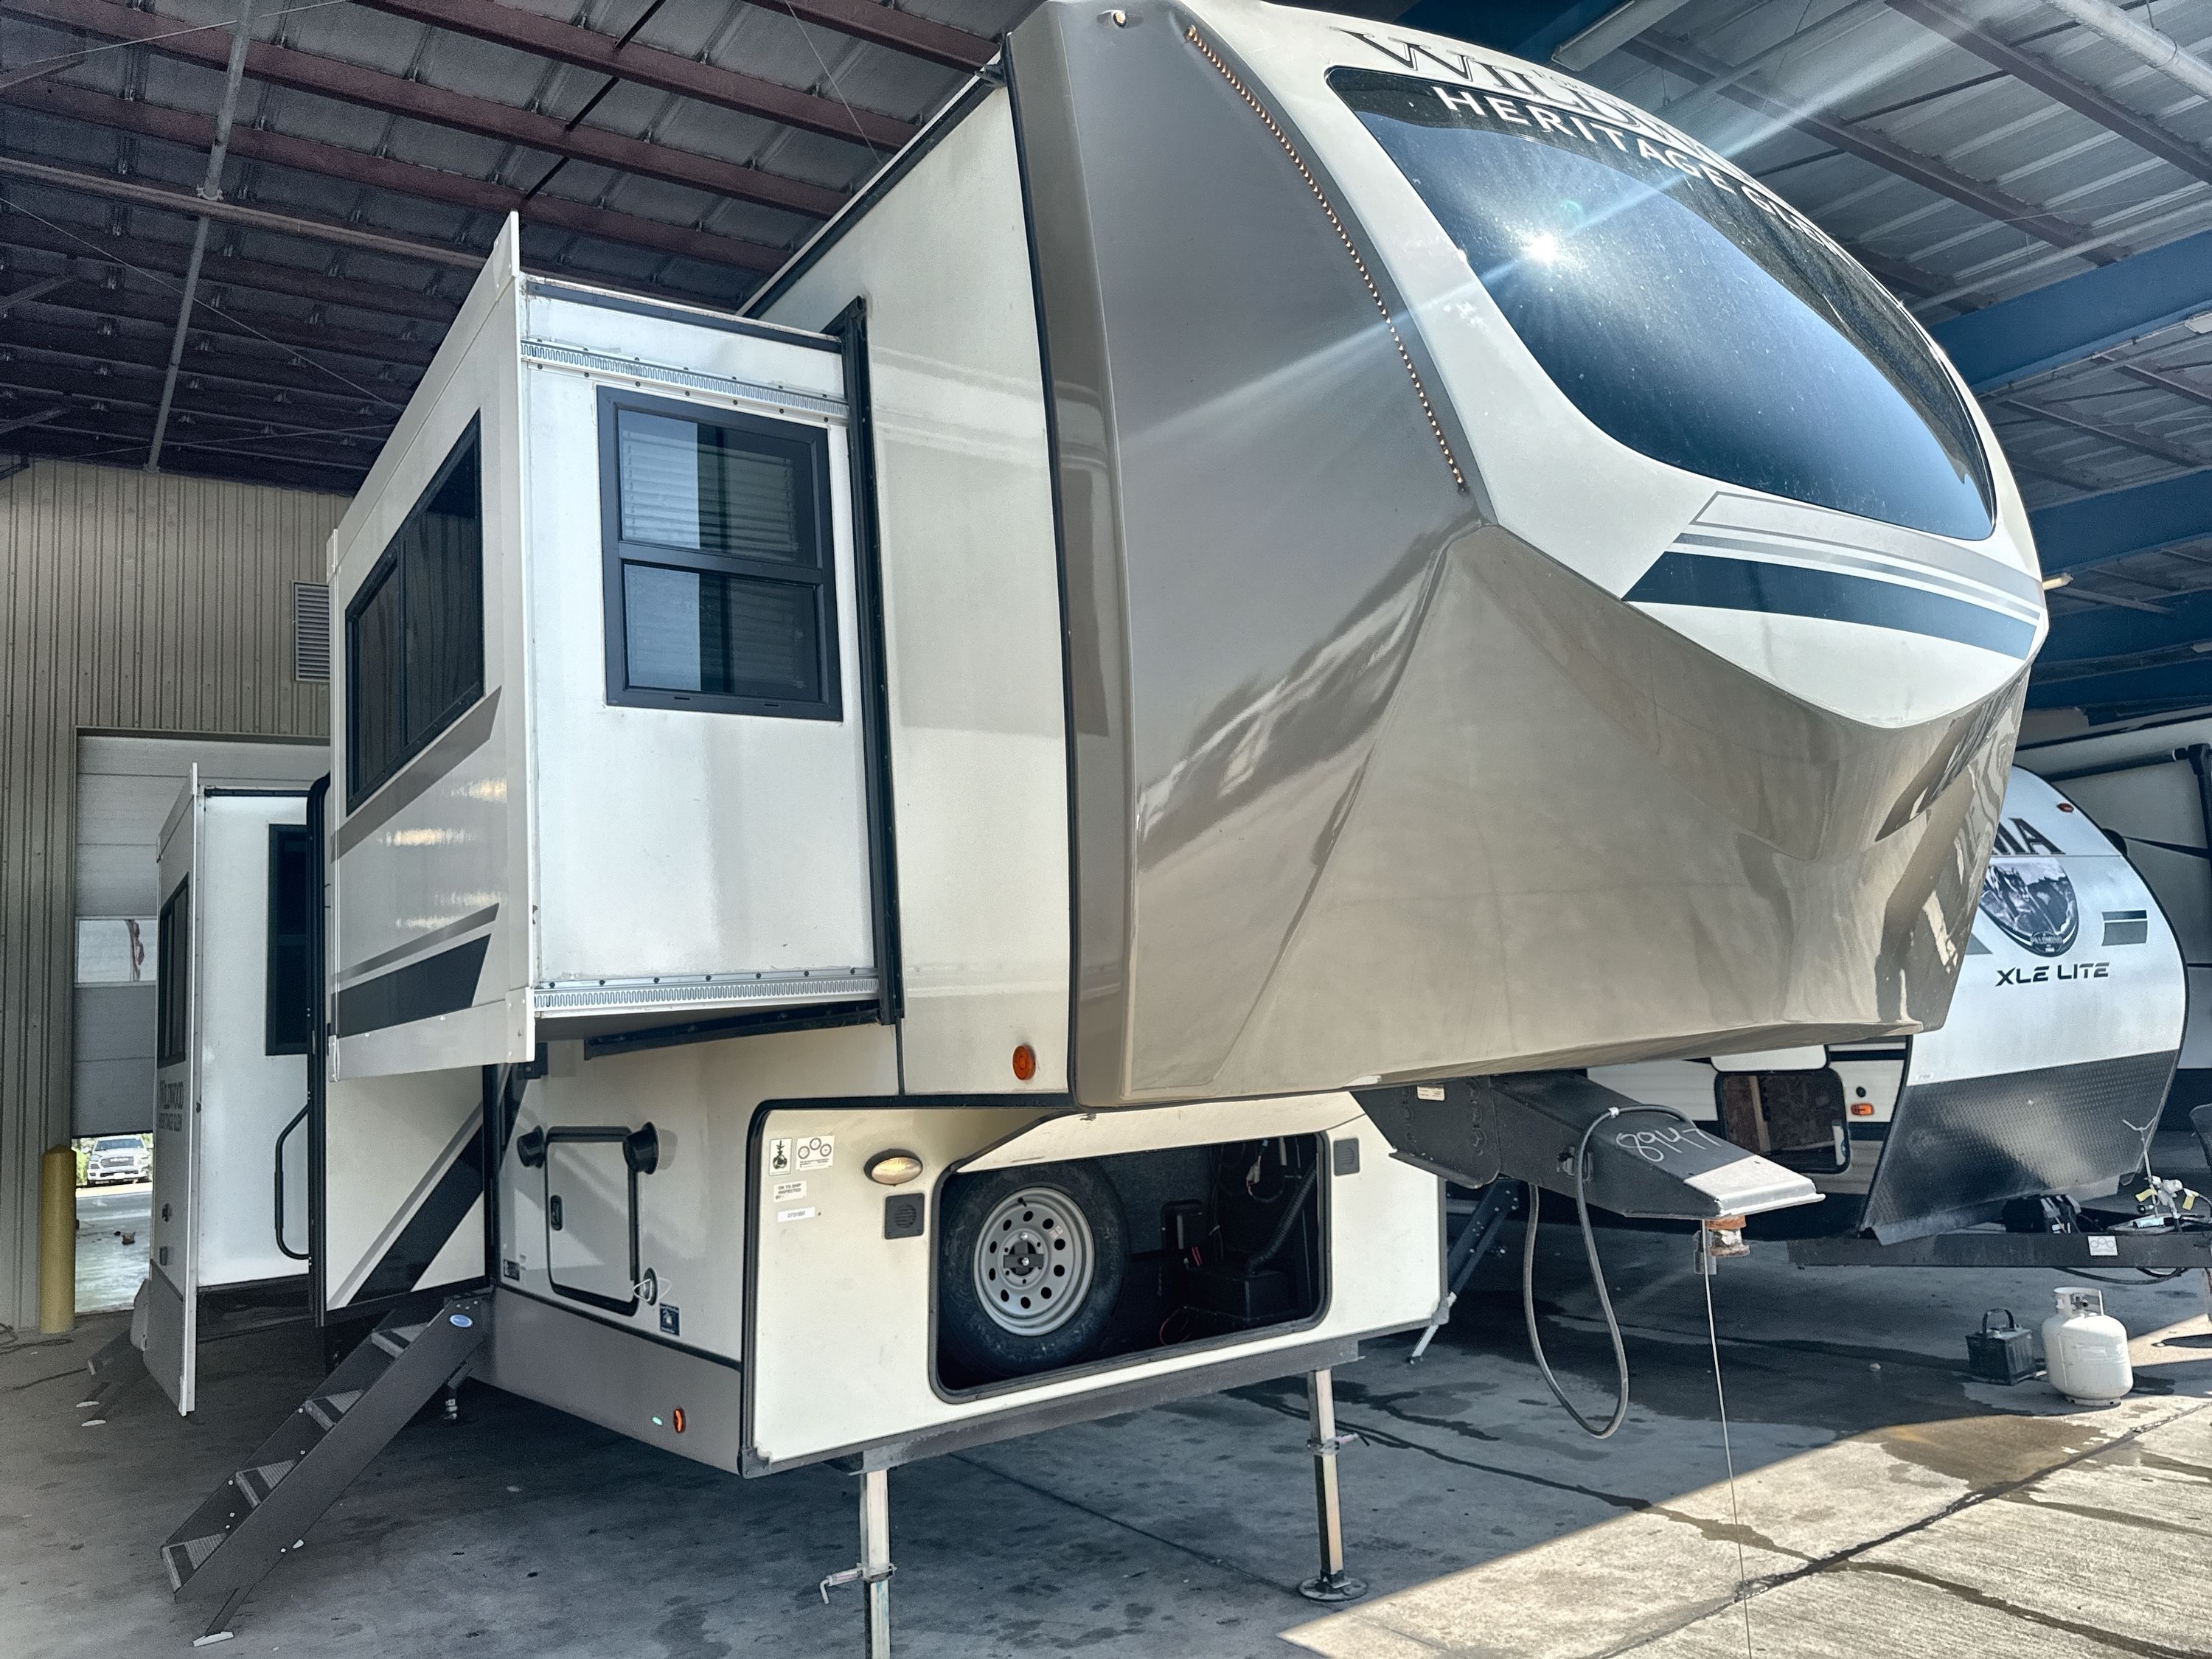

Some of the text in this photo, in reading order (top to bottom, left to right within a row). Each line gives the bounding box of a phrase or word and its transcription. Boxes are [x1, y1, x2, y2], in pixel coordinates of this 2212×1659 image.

[1432, 86, 1736, 195] HERITAGE
[1994, 962, 2110, 987] XLE LITE
